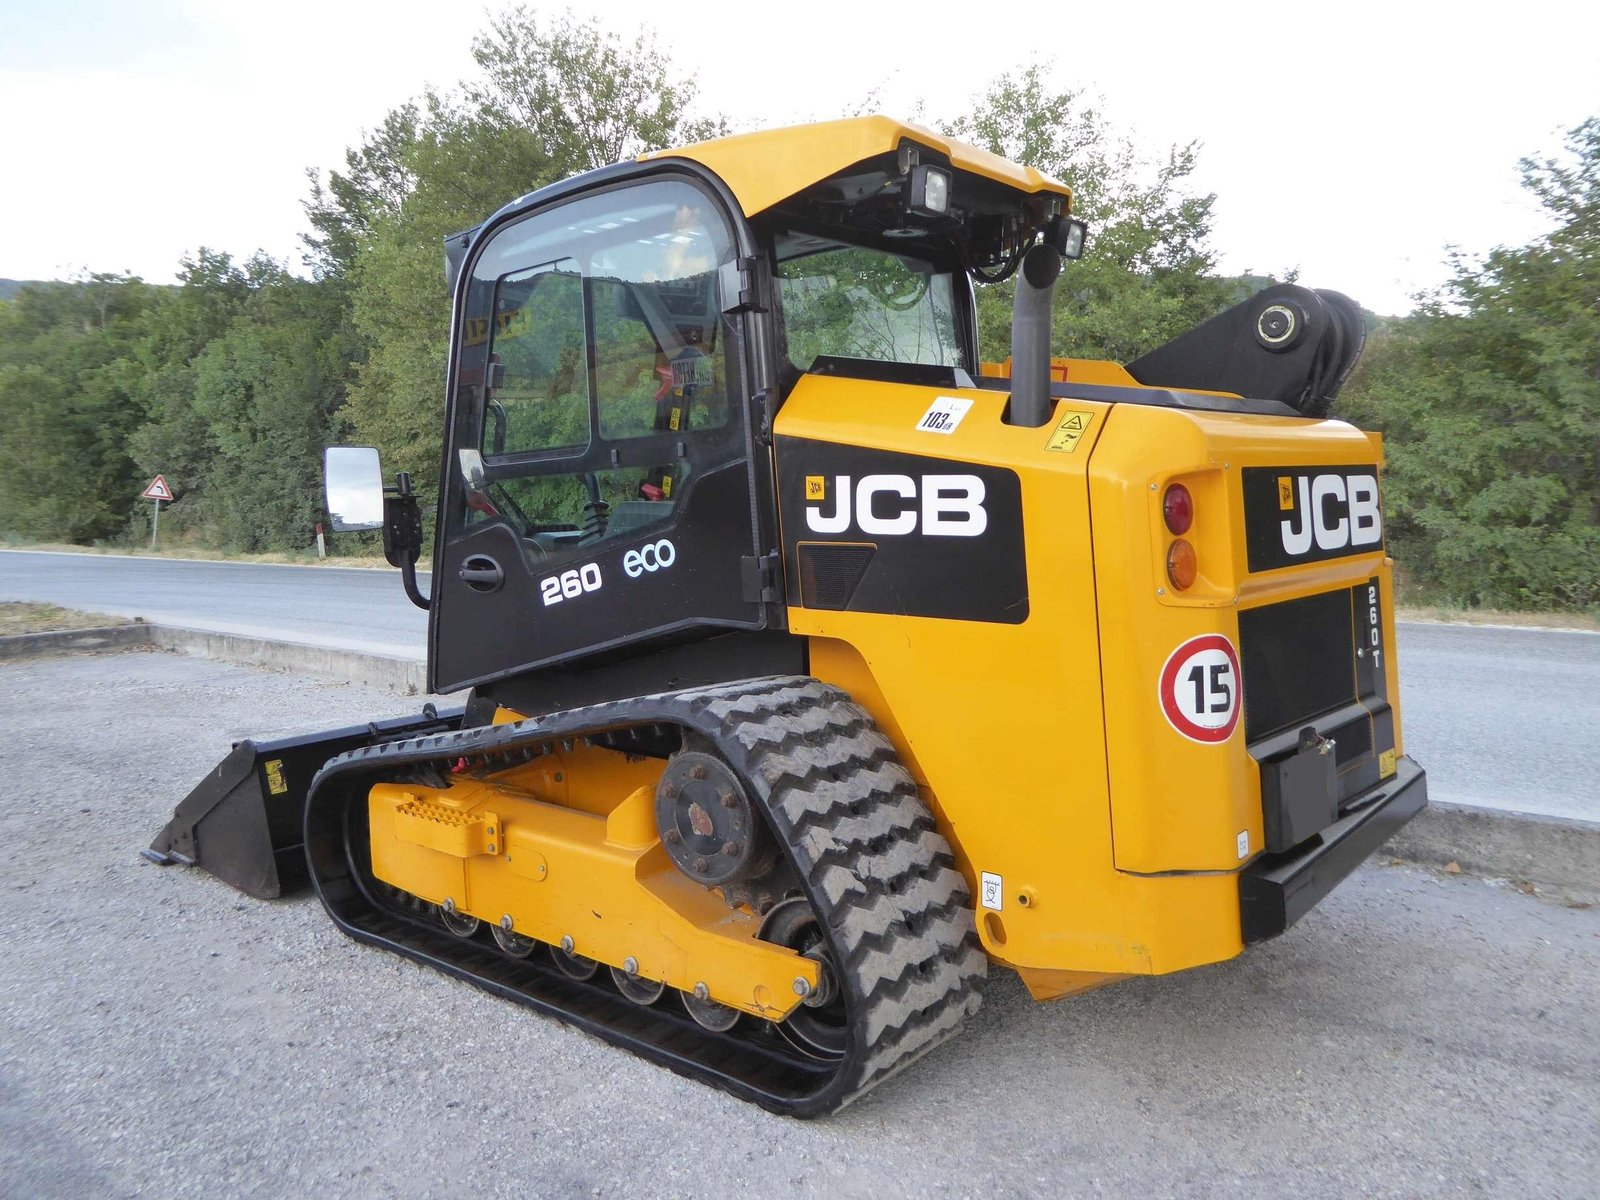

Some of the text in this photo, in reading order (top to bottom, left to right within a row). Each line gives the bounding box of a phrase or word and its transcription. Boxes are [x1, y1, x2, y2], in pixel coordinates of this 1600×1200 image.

[922, 411, 950, 429] 103
[806, 475, 988, 537] JCB
[1281, 474, 1382, 555] JCB
[623, 539, 676, 578] eco
[540, 562, 603, 607] 260
[1368, 586, 1380, 668] 260T
[1188, 663, 1232, 714] 15
